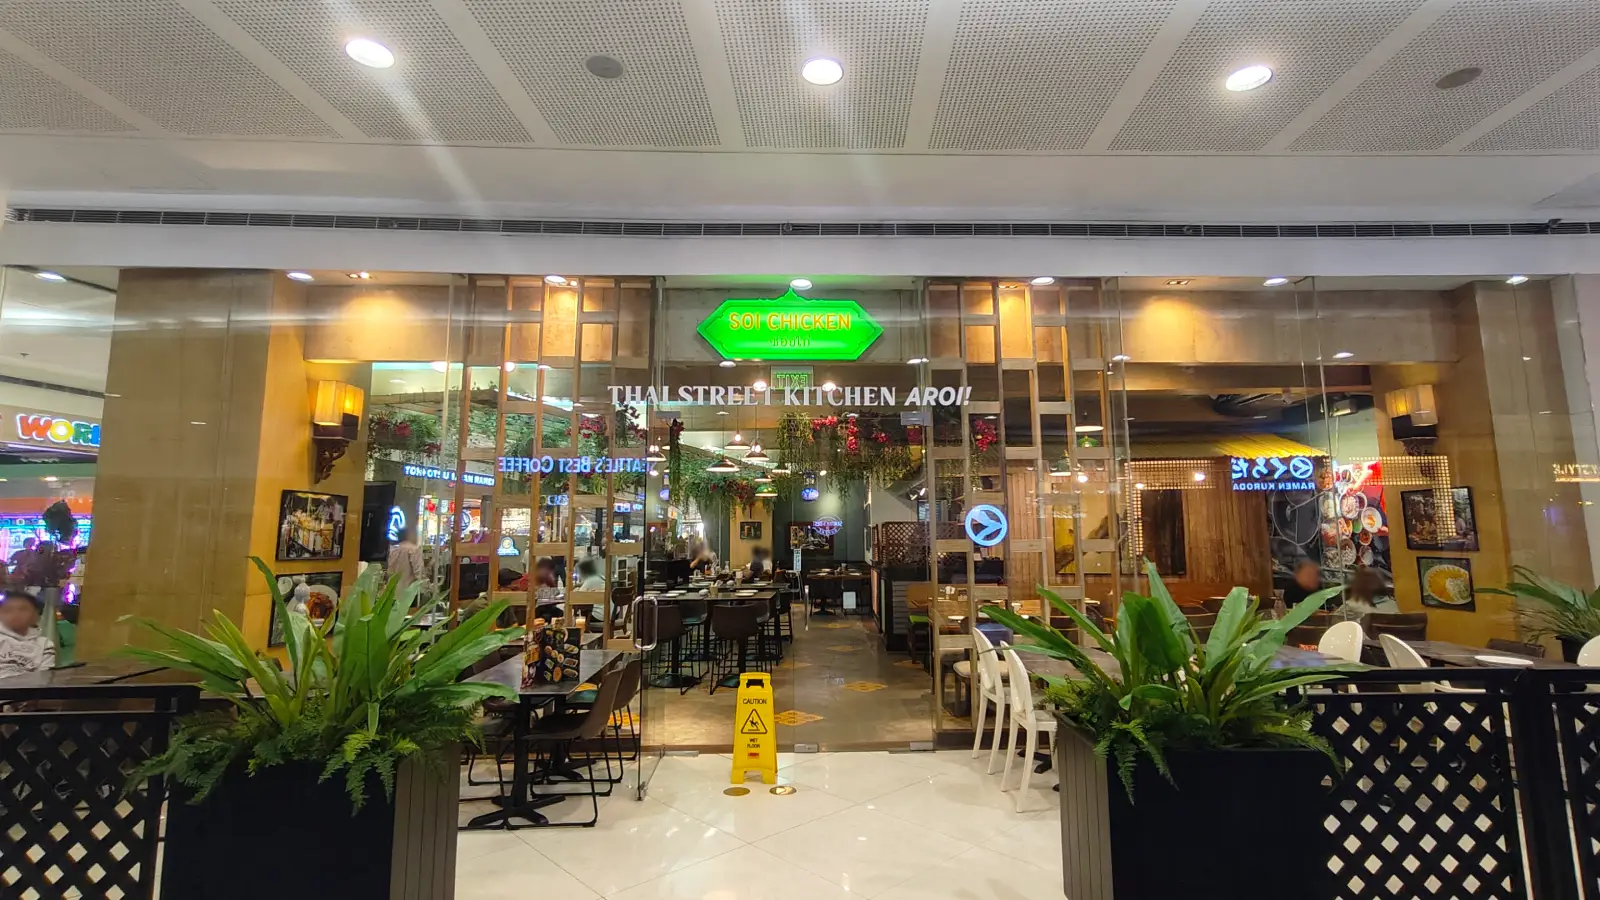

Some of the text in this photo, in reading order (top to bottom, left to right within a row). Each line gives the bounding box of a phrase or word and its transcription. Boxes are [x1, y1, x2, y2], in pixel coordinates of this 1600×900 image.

[729, 312, 851, 330] SOI CHICKEN
[677, 385, 775, 406] STREET
[784, 386, 897, 406] KITCHEN
[904, 386, 972, 406] AROI!
